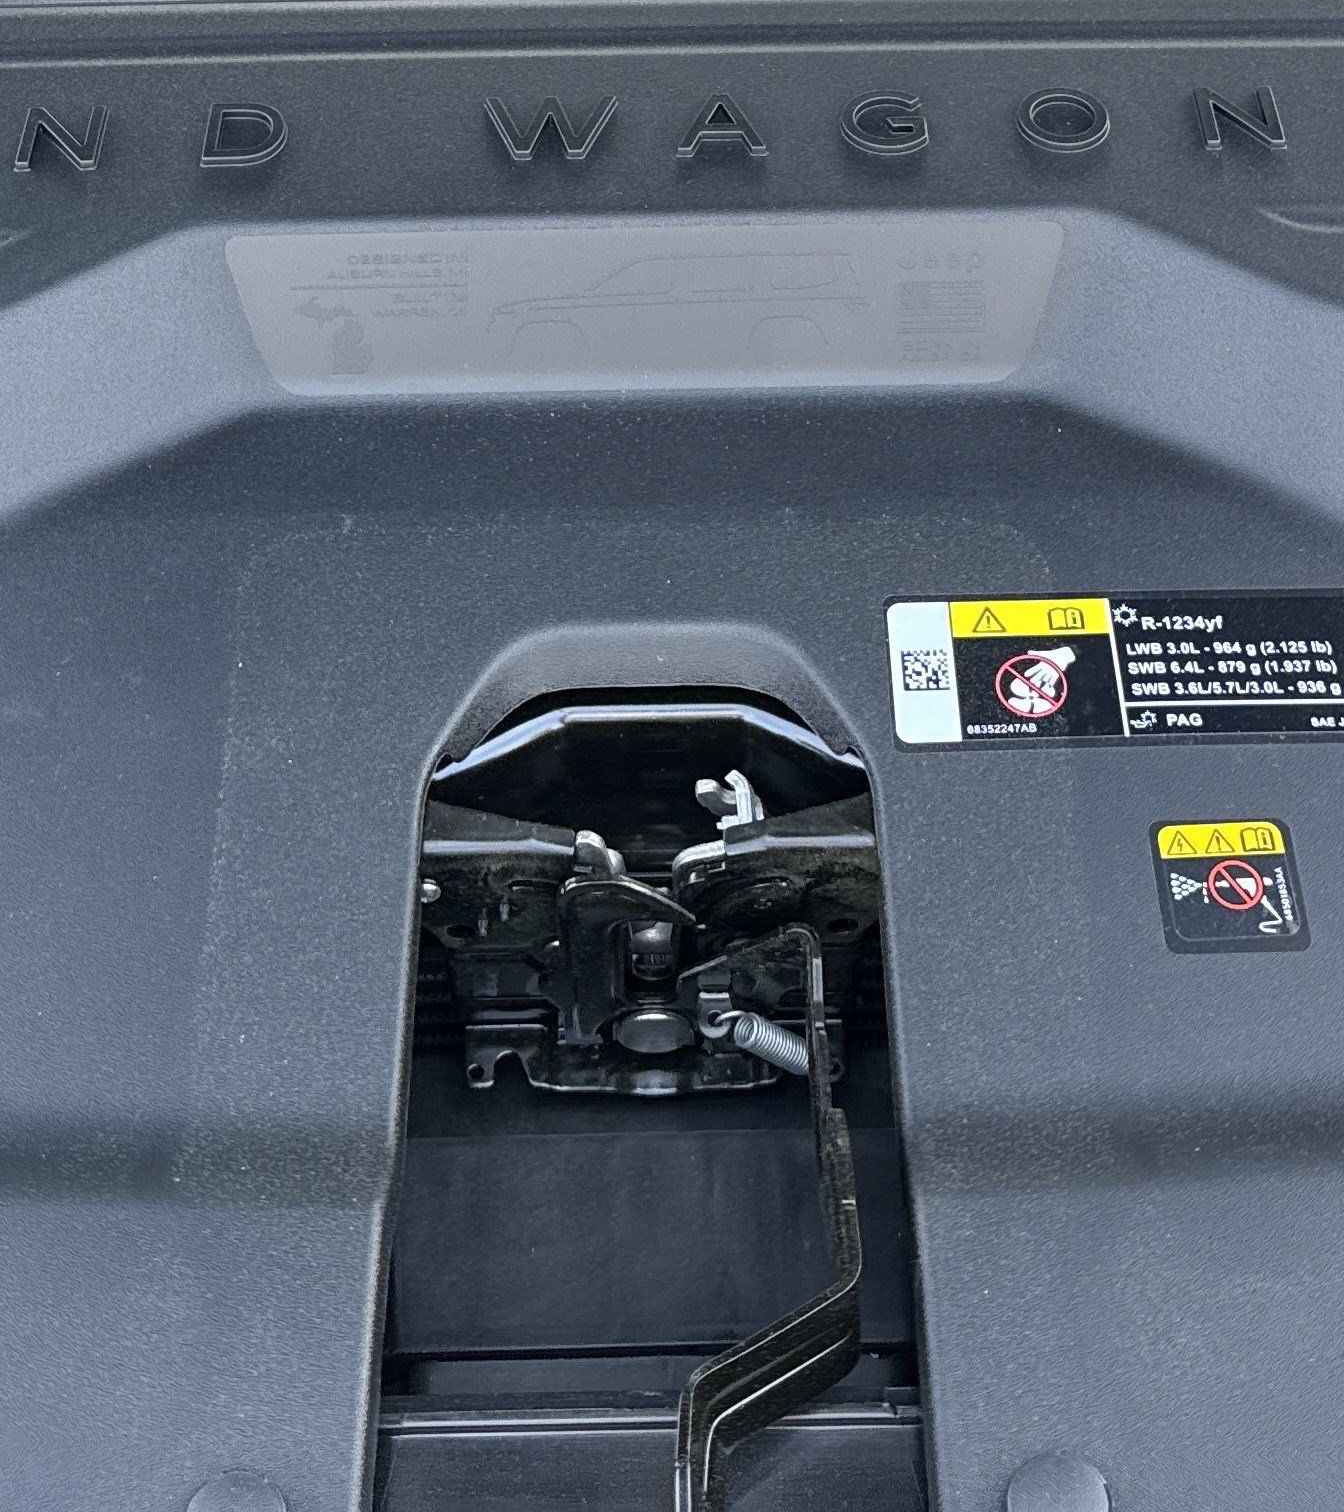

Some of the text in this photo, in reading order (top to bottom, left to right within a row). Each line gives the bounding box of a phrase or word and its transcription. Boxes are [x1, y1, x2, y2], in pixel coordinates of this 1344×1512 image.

[1141, 616, 1223, 633] R-1234yf
[1126, 642, 1163, 655] LWB
[1166, 642, 1200, 655] 3.0L
[1213, 641, 1242, 654] 964
[1245, 644, 1257, 657] g
[1260, 640, 1308, 656] (2.125
[1311, 641, 1333, 656] lb)
[1128, 661, 1167, 675] SWB
[1170, 661, 1204, 674] 6.4L
[1217, 661, 1246, 674] 879
[1249, 662, 1261, 676] g
[1264, 660, 1311, 675] (1.937
[1316, 660, 1338, 675] lb)
[1131, 682, 1171, 696] SWB
[1174, 681, 1285, 695] 3.6L/5.7L/3.0L
[1297, 680, 1326, 694] 936
[1330, 682, 1342, 696] g
[1166, 713, 1203, 727] PAG
[1310, 717, 1336, 727] SAE
